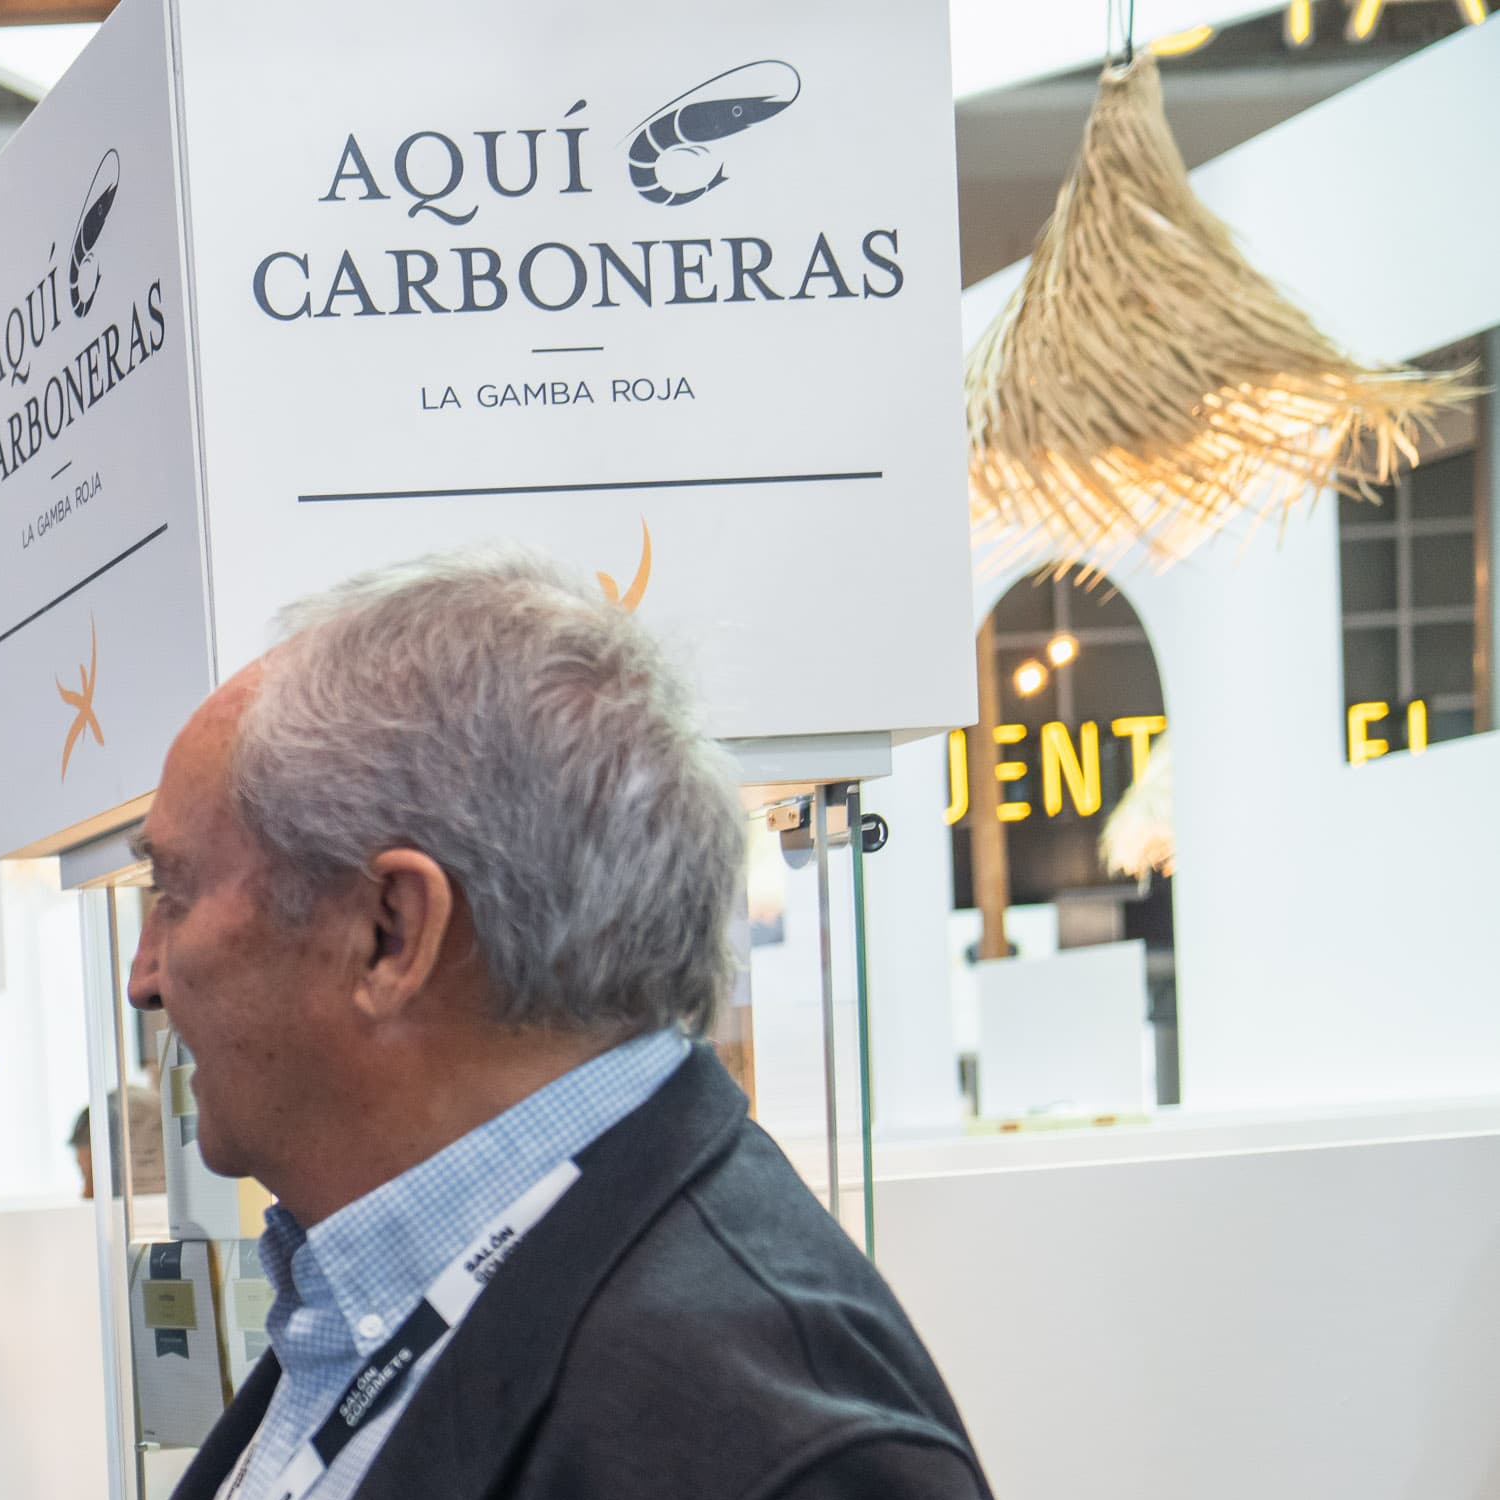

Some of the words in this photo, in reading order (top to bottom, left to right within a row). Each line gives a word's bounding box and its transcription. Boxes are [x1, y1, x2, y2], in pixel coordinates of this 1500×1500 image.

[318, 99, 593, 226] AQUÍ
[253, 229, 904, 321] CARBONERAS
[421, 386, 462, 410] LA
[477, 380, 594, 408] GAMBA
[612, 376, 695, 403] ROJA
[22, 521, 34, 549] LA
[37, 495, 72, 537] GAMBA
[75, 472, 103, 509] ROJA
[345, 1347, 413, 1427] GOURMETS
